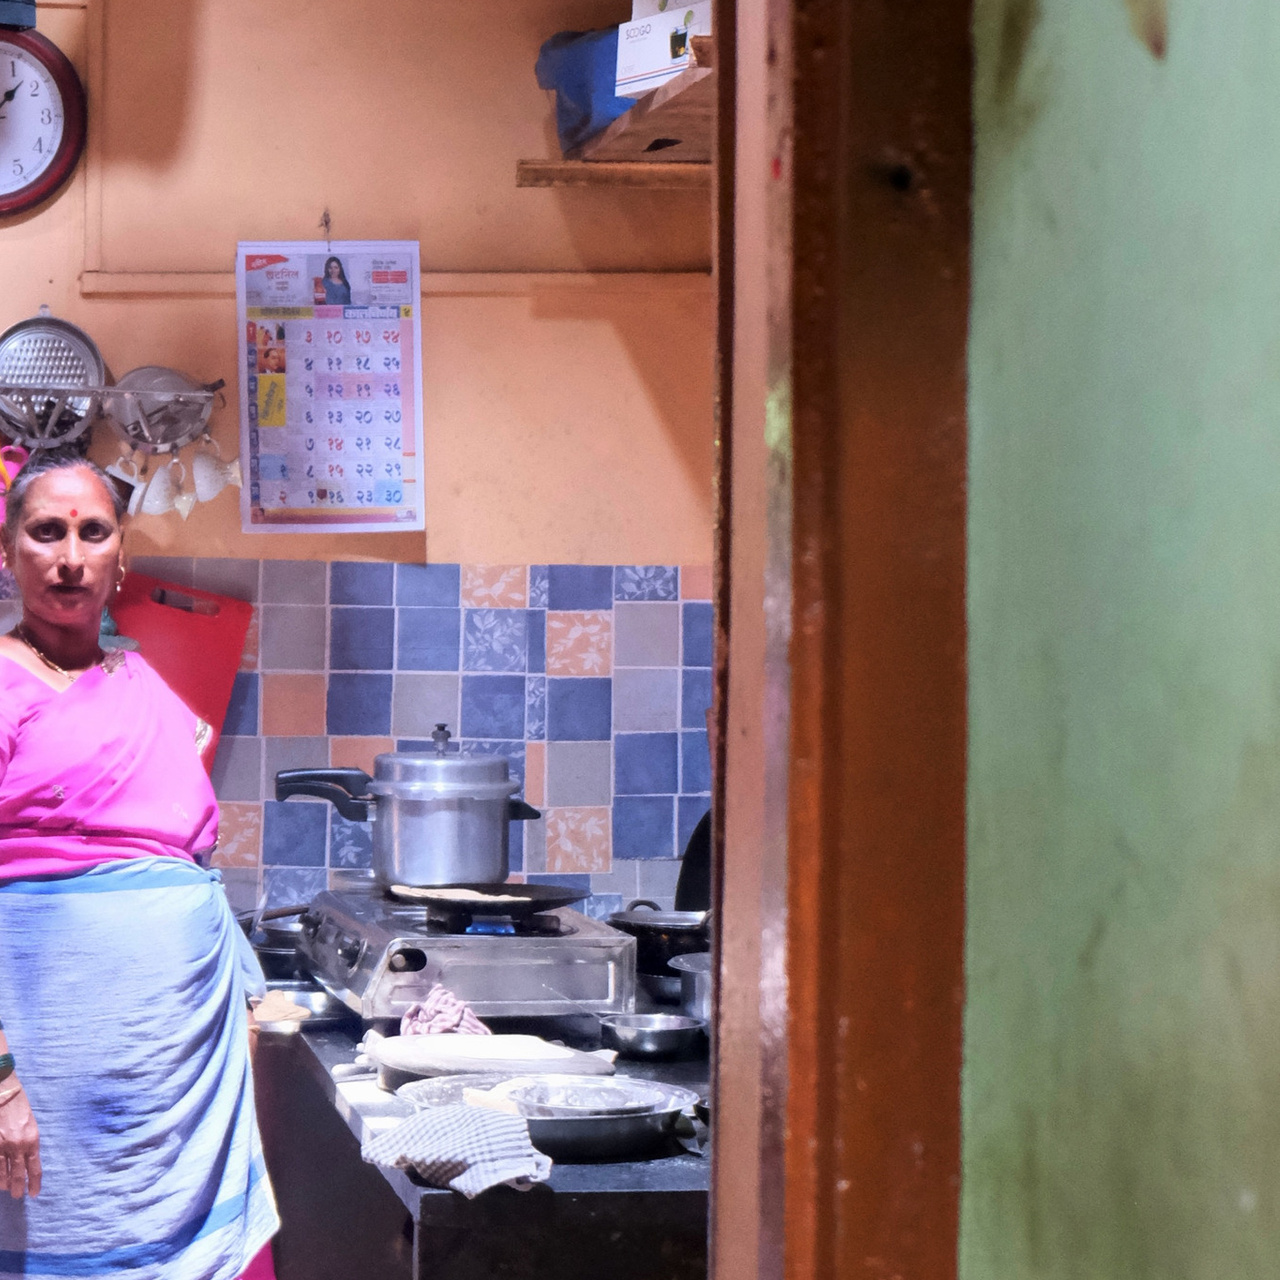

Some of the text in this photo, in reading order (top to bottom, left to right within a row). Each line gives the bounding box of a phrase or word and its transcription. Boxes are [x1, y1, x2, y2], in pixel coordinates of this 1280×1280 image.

[10, 61, 17, 78] 1
[30, 80, 40, 97] 2
[41, 108, 52, 125] 3
[32, 137, 43, 154] 4
[13, 159, 24, 176] 5
[327, 330, 343, 344] १०
[356, 330, 371, 343] १७
[382, 330, 400, 343] २४
[328, 357, 342, 370] ११
[356, 357, 370, 370] १८
[383, 357, 400, 370] २५
[328, 384, 343, 397] १२
[357, 384, 370, 396] १९
[384, 384, 400, 396] २६
[328, 411, 343, 424] १३
[355, 411, 372, 424] २०
[384, 410, 401, 423] २७
[328, 437, 343, 451] १४
[356, 437, 371, 451] २१
[384, 437, 401, 450] २८
[328, 464, 343, 477] १५
[356, 464, 373, 477] २२
[385, 463, 401, 477] २९
[328, 490, 344, 504] १६
[357, 490, 373, 503] २३
[385, 490, 402, 503] ३०
